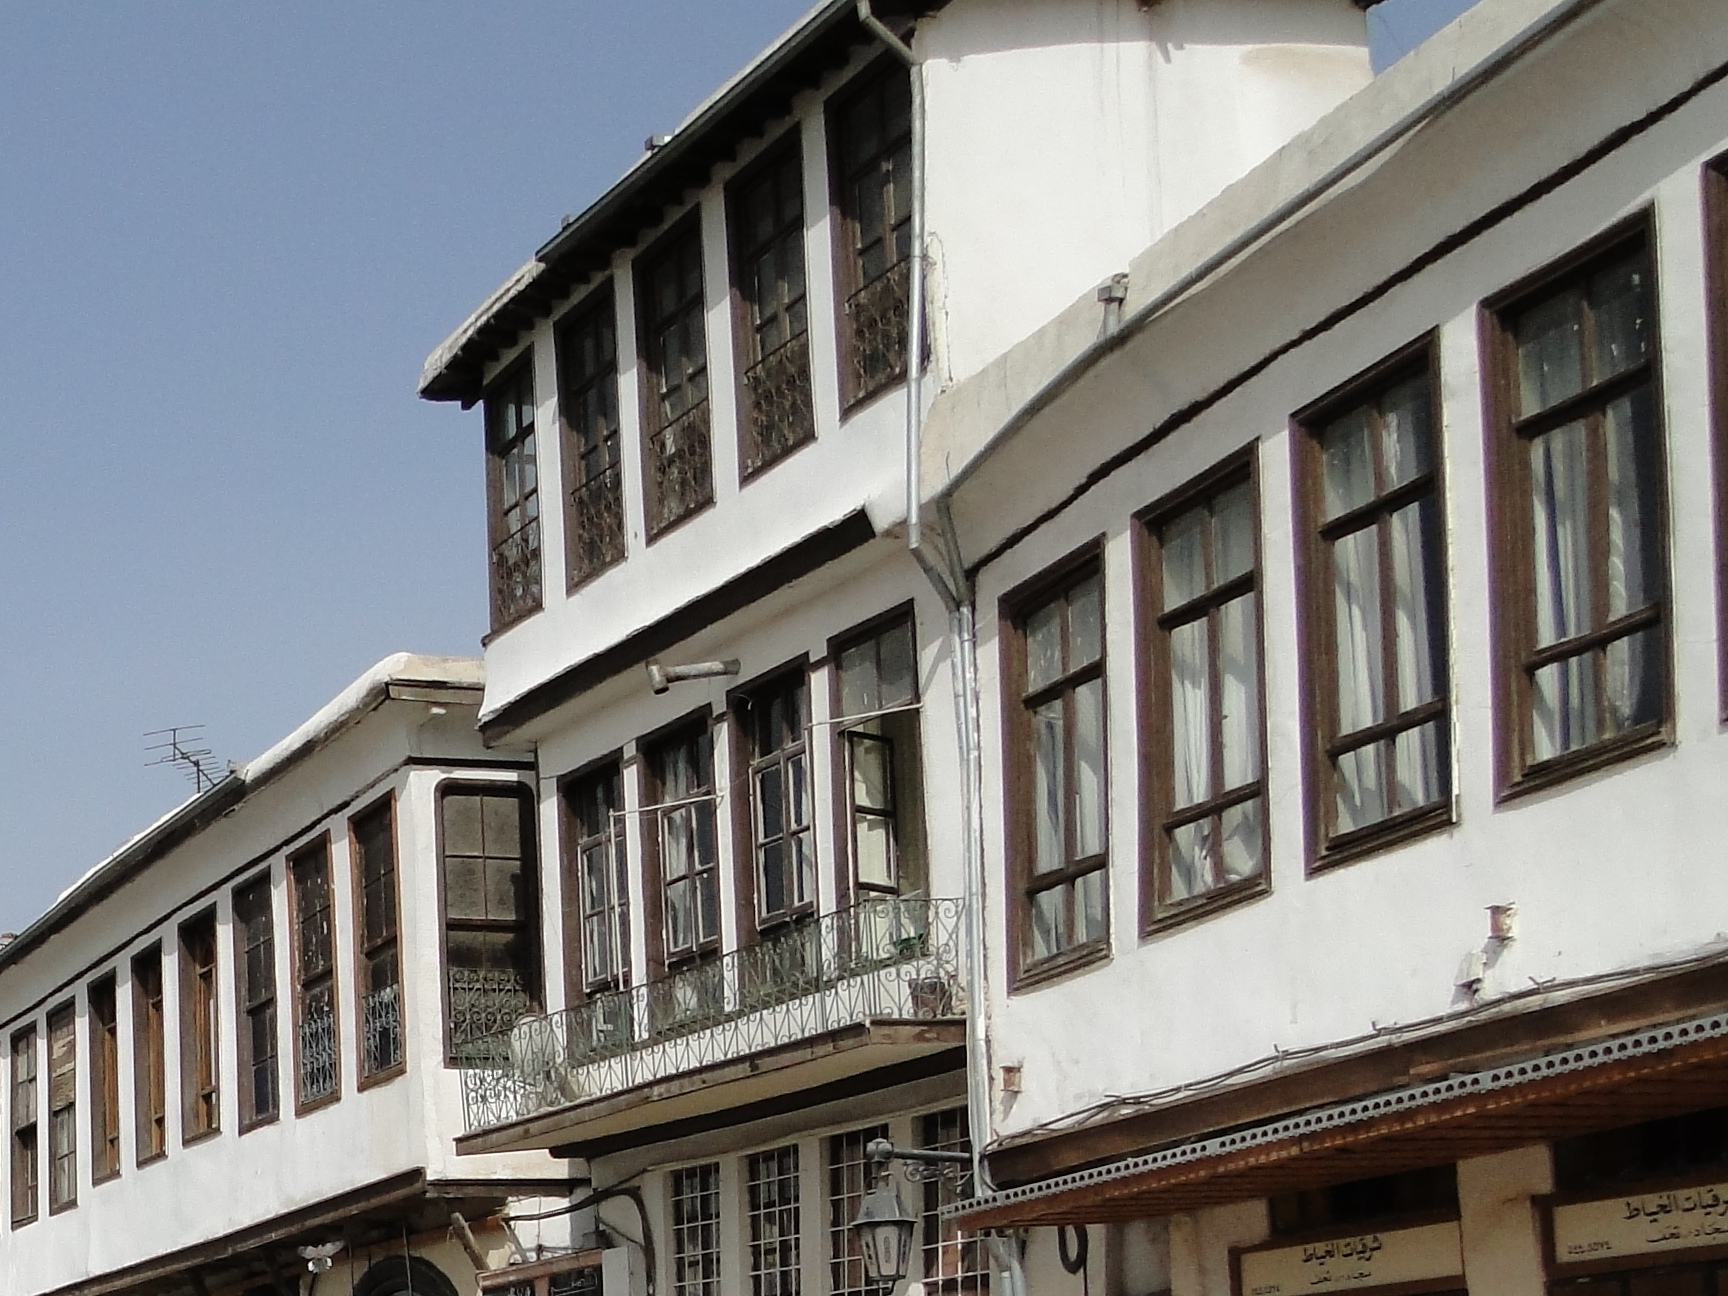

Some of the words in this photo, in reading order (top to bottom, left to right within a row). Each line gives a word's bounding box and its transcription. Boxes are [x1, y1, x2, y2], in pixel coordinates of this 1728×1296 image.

[1622, 1193, 1679, 1223] الخياط
[1302, 1240, 1341, 1266] الخياط
[1341, 1235, 1382, 1262] شرقيات
